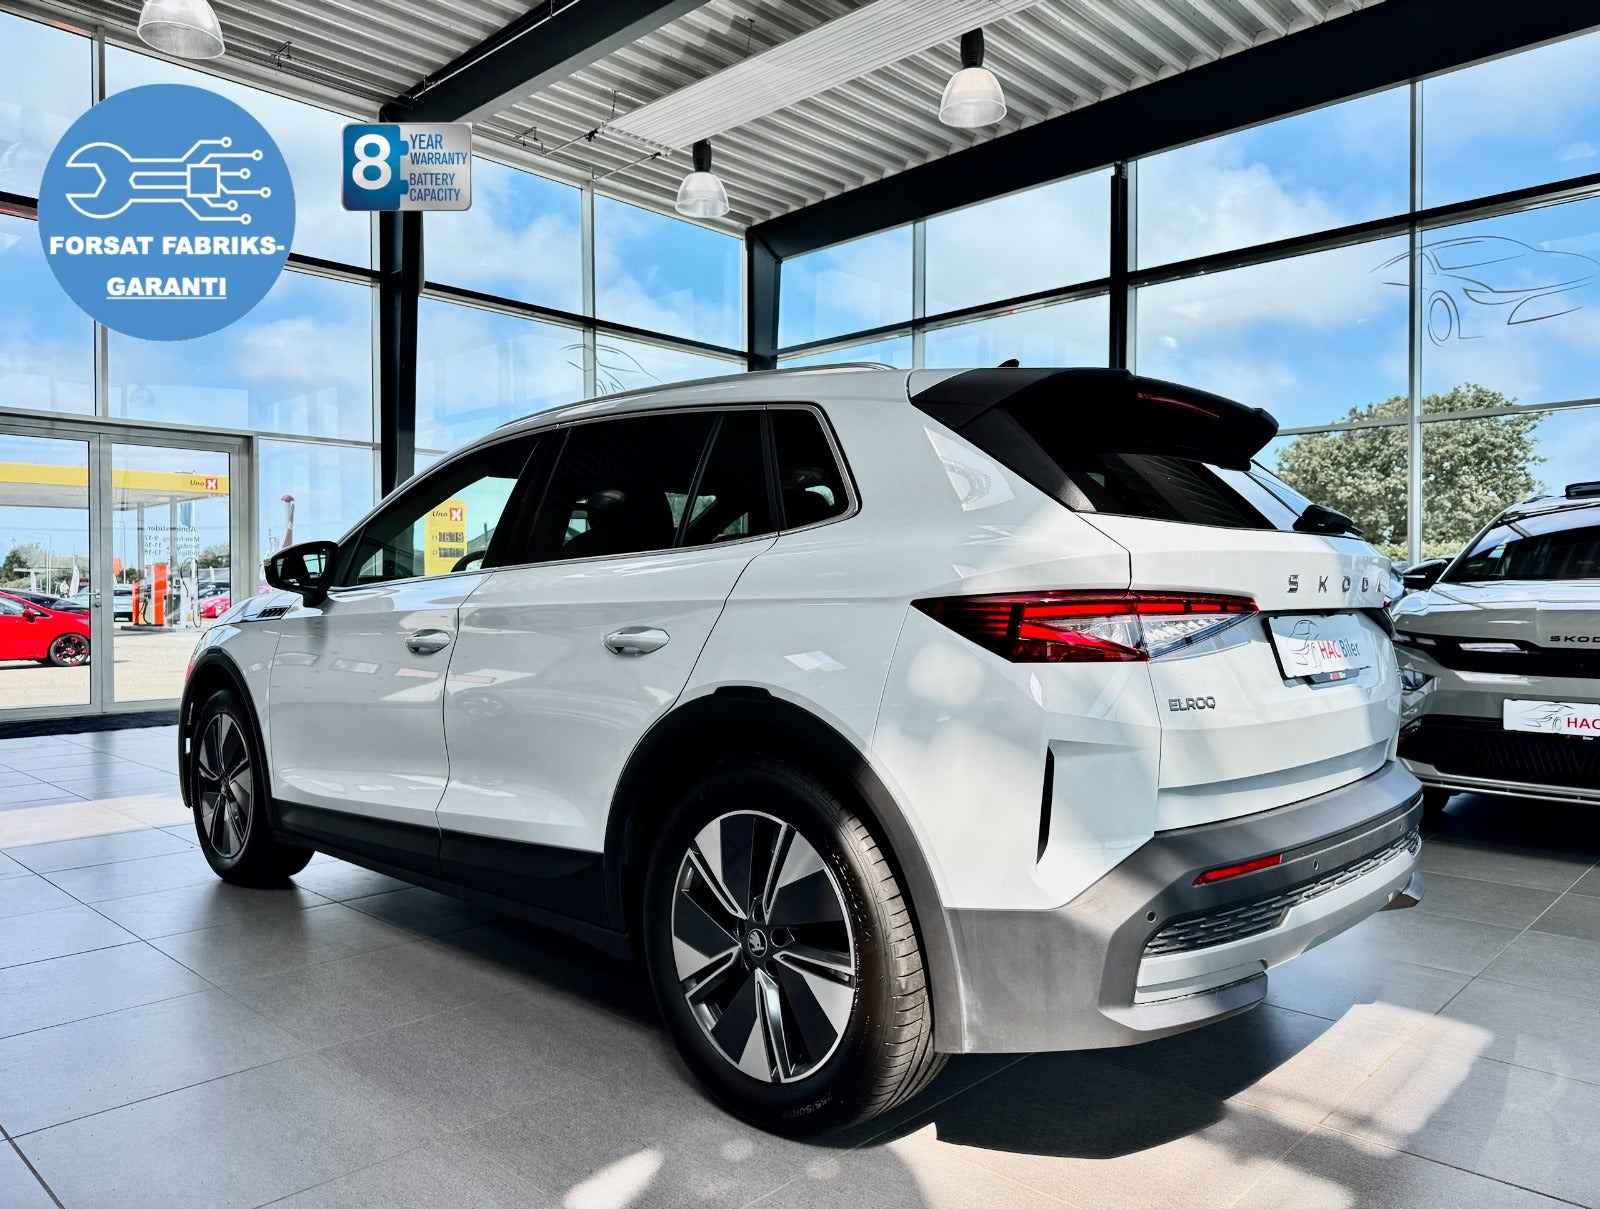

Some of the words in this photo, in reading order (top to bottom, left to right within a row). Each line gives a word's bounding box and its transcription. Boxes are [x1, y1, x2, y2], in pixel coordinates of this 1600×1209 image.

[190, 479, 204, 487] Uno
[1318, 640, 1342, 660] HAC
[1339, 638, 1361, 658] Biler
[1168, 696, 1216, 712] ELROQ
[1567, 717, 1600, 730] HAC
